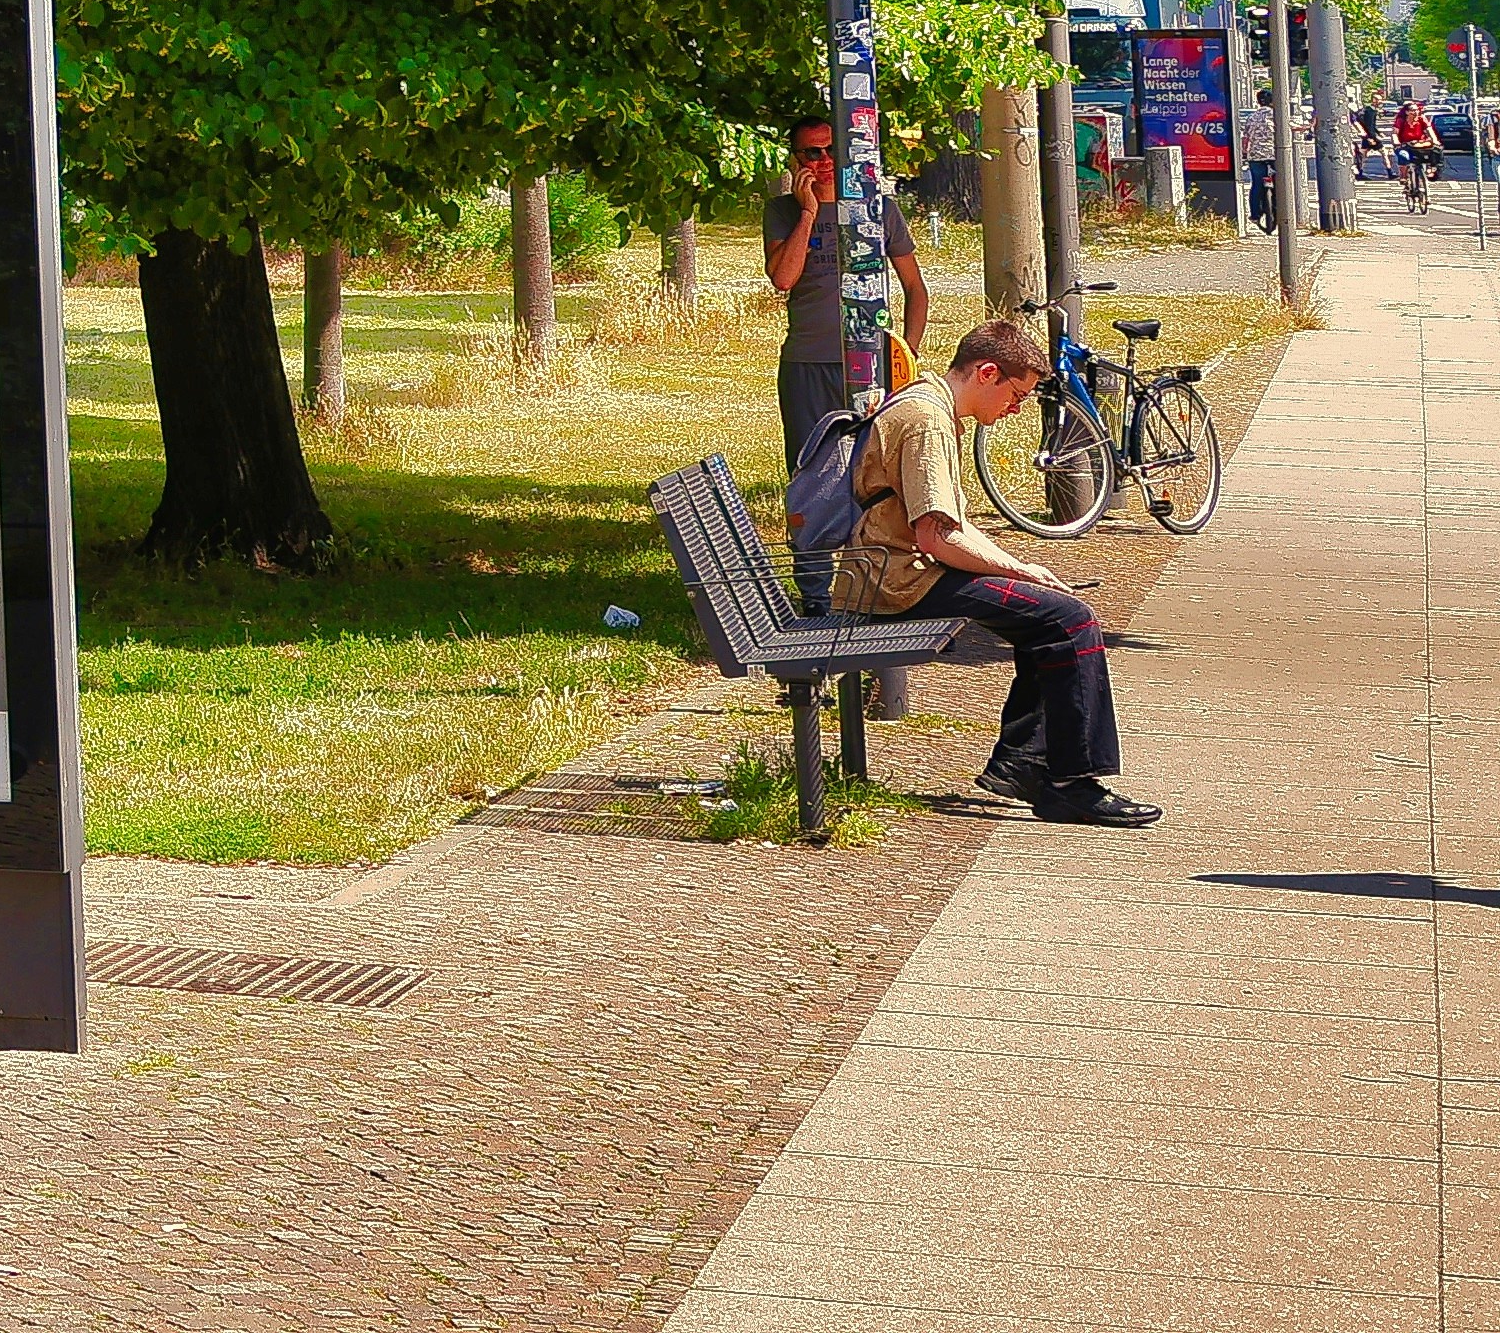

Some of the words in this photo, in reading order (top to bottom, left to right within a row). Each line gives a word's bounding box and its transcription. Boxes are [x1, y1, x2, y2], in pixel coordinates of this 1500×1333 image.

[1142, 56, 1179, 70] Lange
[1143, 67, 1180, 79] Nacht
[1180, 67, 1200, 79] der
[1143, 79, 1186, 91] Wissen
[1145, 103, 1188, 117] Leipzig
[1173, 121, 1225, 136] 20/6/25
